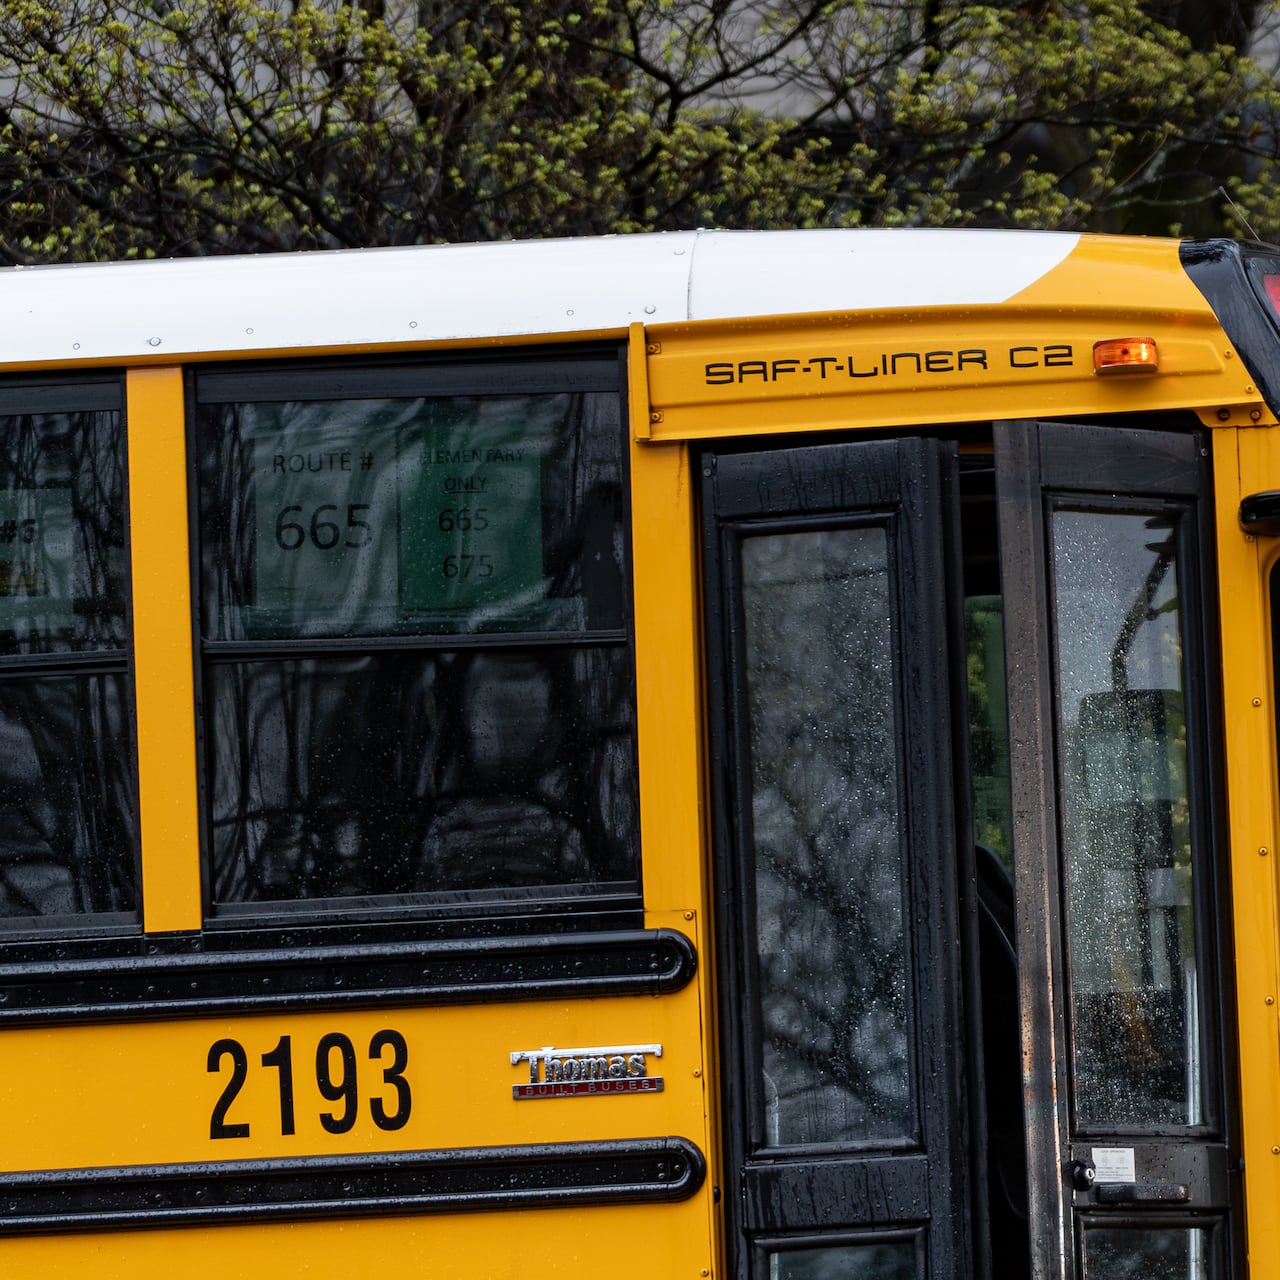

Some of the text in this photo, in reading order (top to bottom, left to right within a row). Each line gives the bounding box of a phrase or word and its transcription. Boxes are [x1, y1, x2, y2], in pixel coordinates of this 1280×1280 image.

[704, 344, 1074, 386] SAF-T-LINER C2
[272, 451, 374, 474] ROUTE #
[420, 448, 526, 466] ELEMENTARY
[443, 476, 488, 492] ONLY
[275, 503, 373, 551] 665
[438, 508, 489, 533] 665
[442, 554, 494, 579] 675
[510, 1044, 663, 1084] Thomas
[206, 1029, 412, 1140] 2193
[524, 1079, 651, 1096] BUILT BUSES
